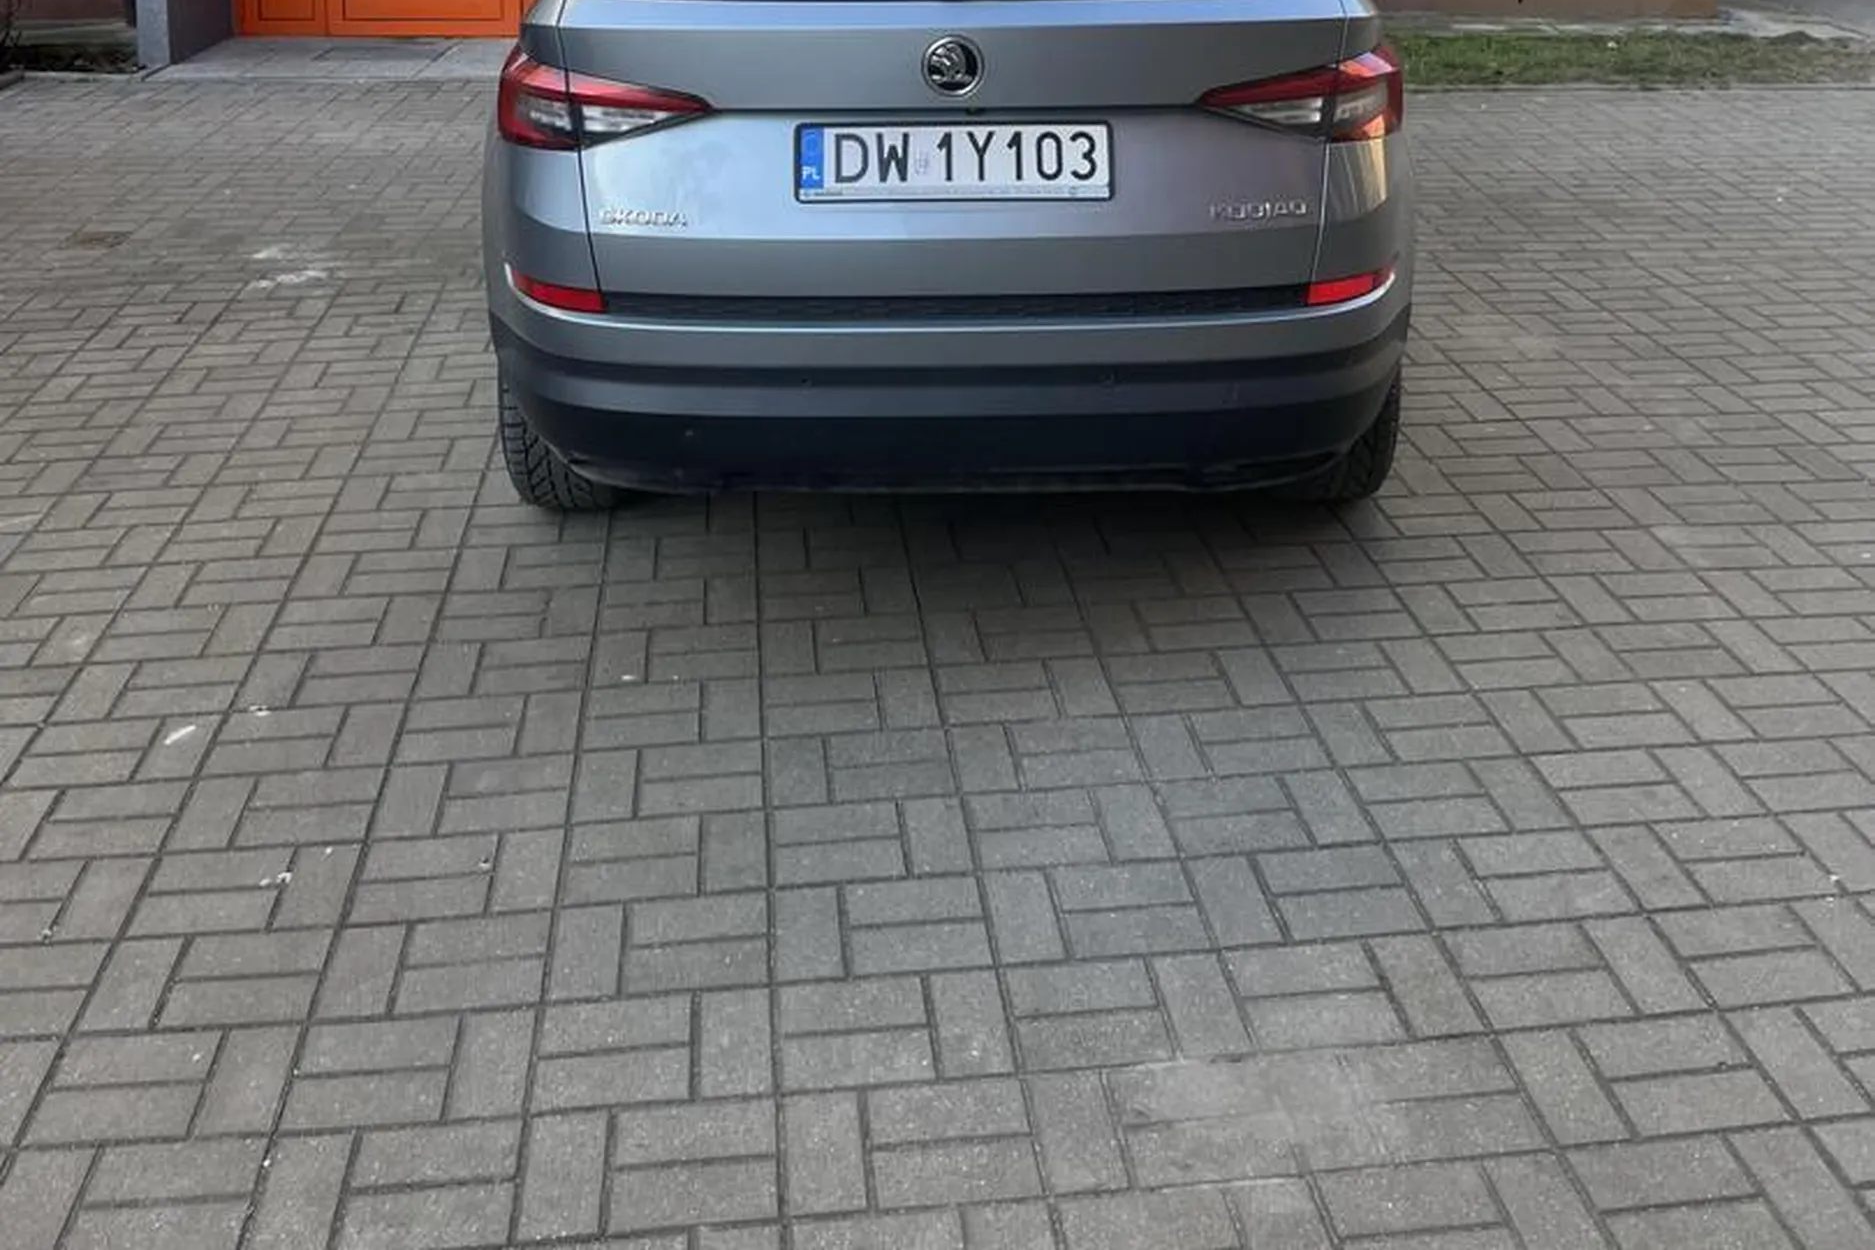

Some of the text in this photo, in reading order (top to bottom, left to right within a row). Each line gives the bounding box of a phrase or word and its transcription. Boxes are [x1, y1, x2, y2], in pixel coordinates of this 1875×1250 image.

[801, 165, 821, 180] PL
[834, 129, 1098, 184] DW 1Y103
